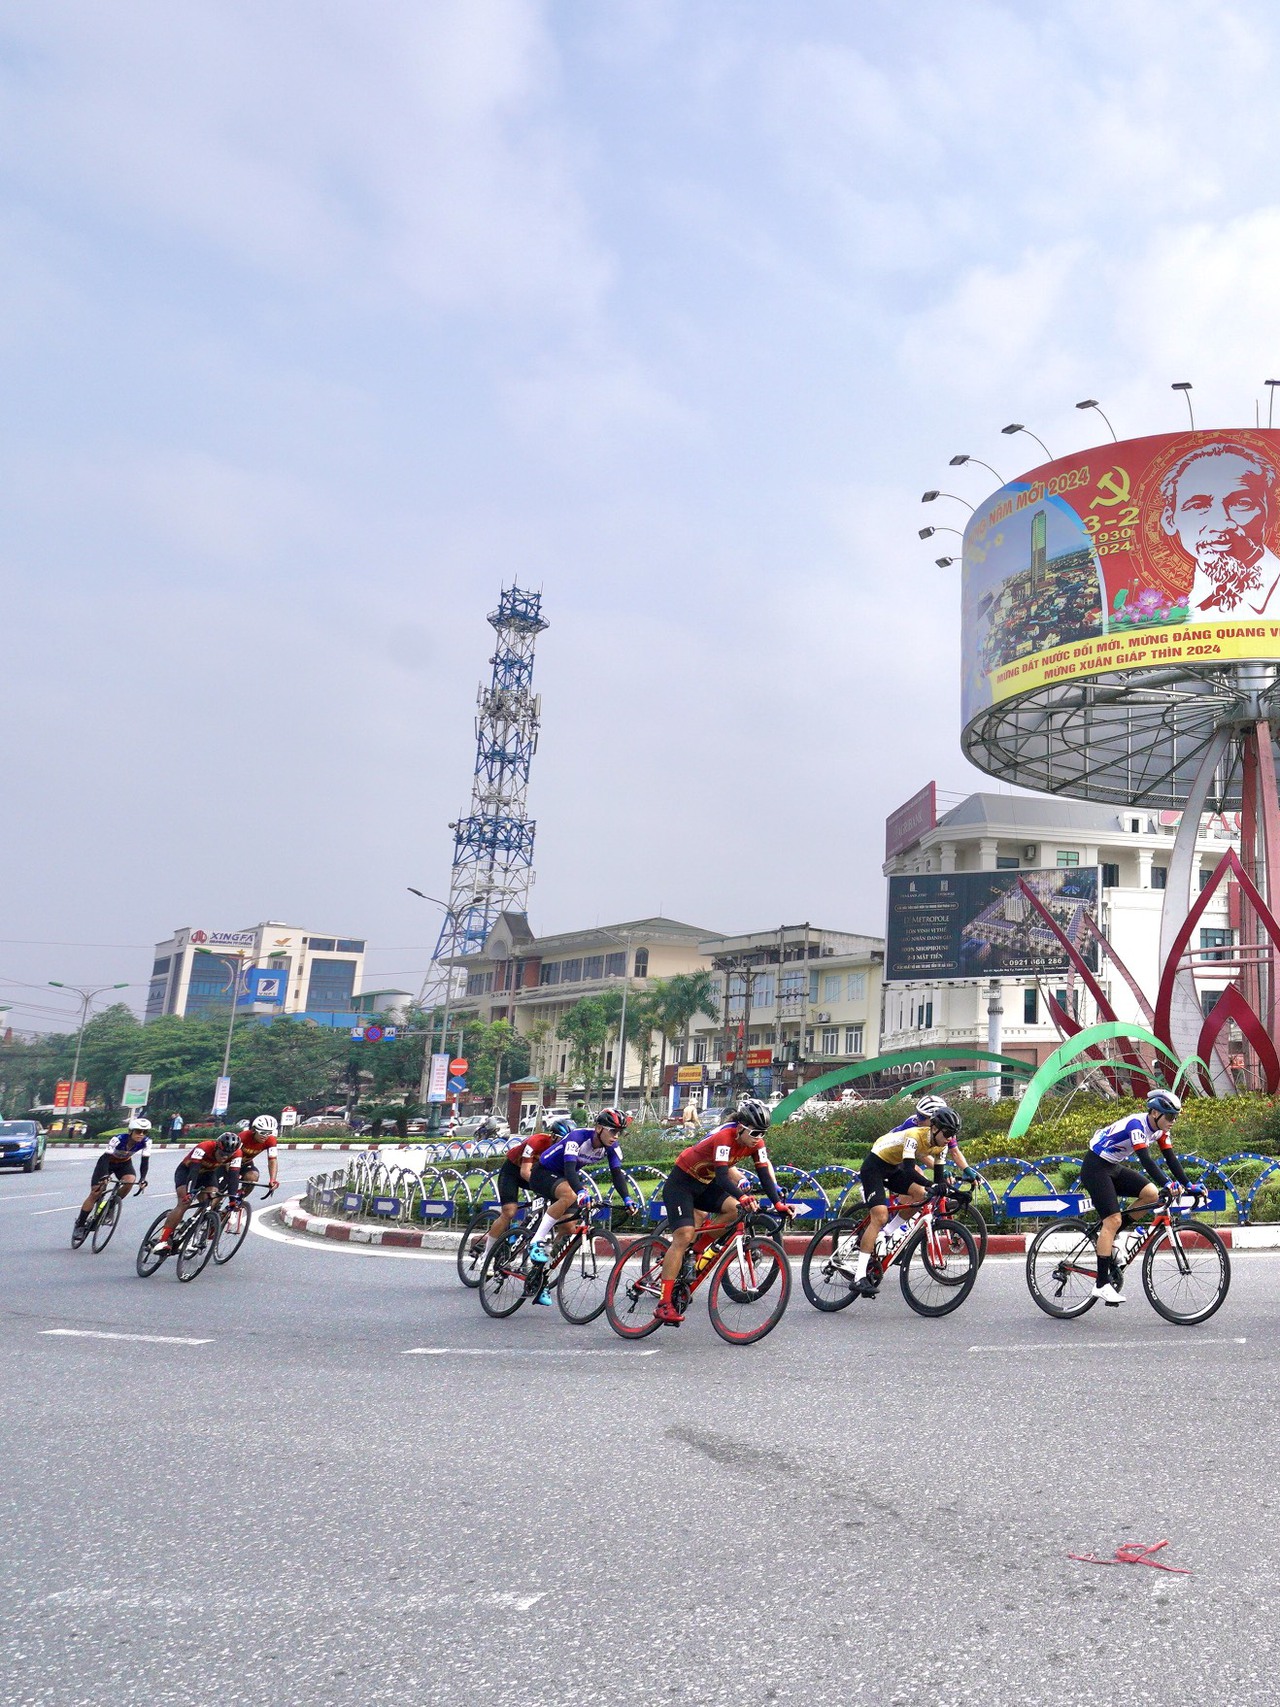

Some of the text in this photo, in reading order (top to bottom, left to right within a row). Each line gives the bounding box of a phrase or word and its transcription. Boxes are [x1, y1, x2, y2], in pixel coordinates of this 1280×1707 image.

[1016, 481, 1046, 511] MỚI
[1048, 465, 1090, 498] 2024
[1082, 507, 1140, 535] 3-2
[1090, 527, 1132, 544] 1930
[1088, 541, 1133, 559] 2024
[996, 665, 1020, 684] MỪNG
[1022, 657, 1039, 673] ĐẤT
[1042, 650, 1070, 666] NƯỚC
[1073, 642, 1093, 658] ĐỔI
[1128, 633, 1169, 648] MỪNG
[1173, 627, 1212, 641] ĐẢNG
[1216, 627, 1266, 639] QUANG
[1044, 644, 1221, 680] MỪNG XUÂN GIÁP THÌN 2024
[210, 931, 254, 942] XINGFA
